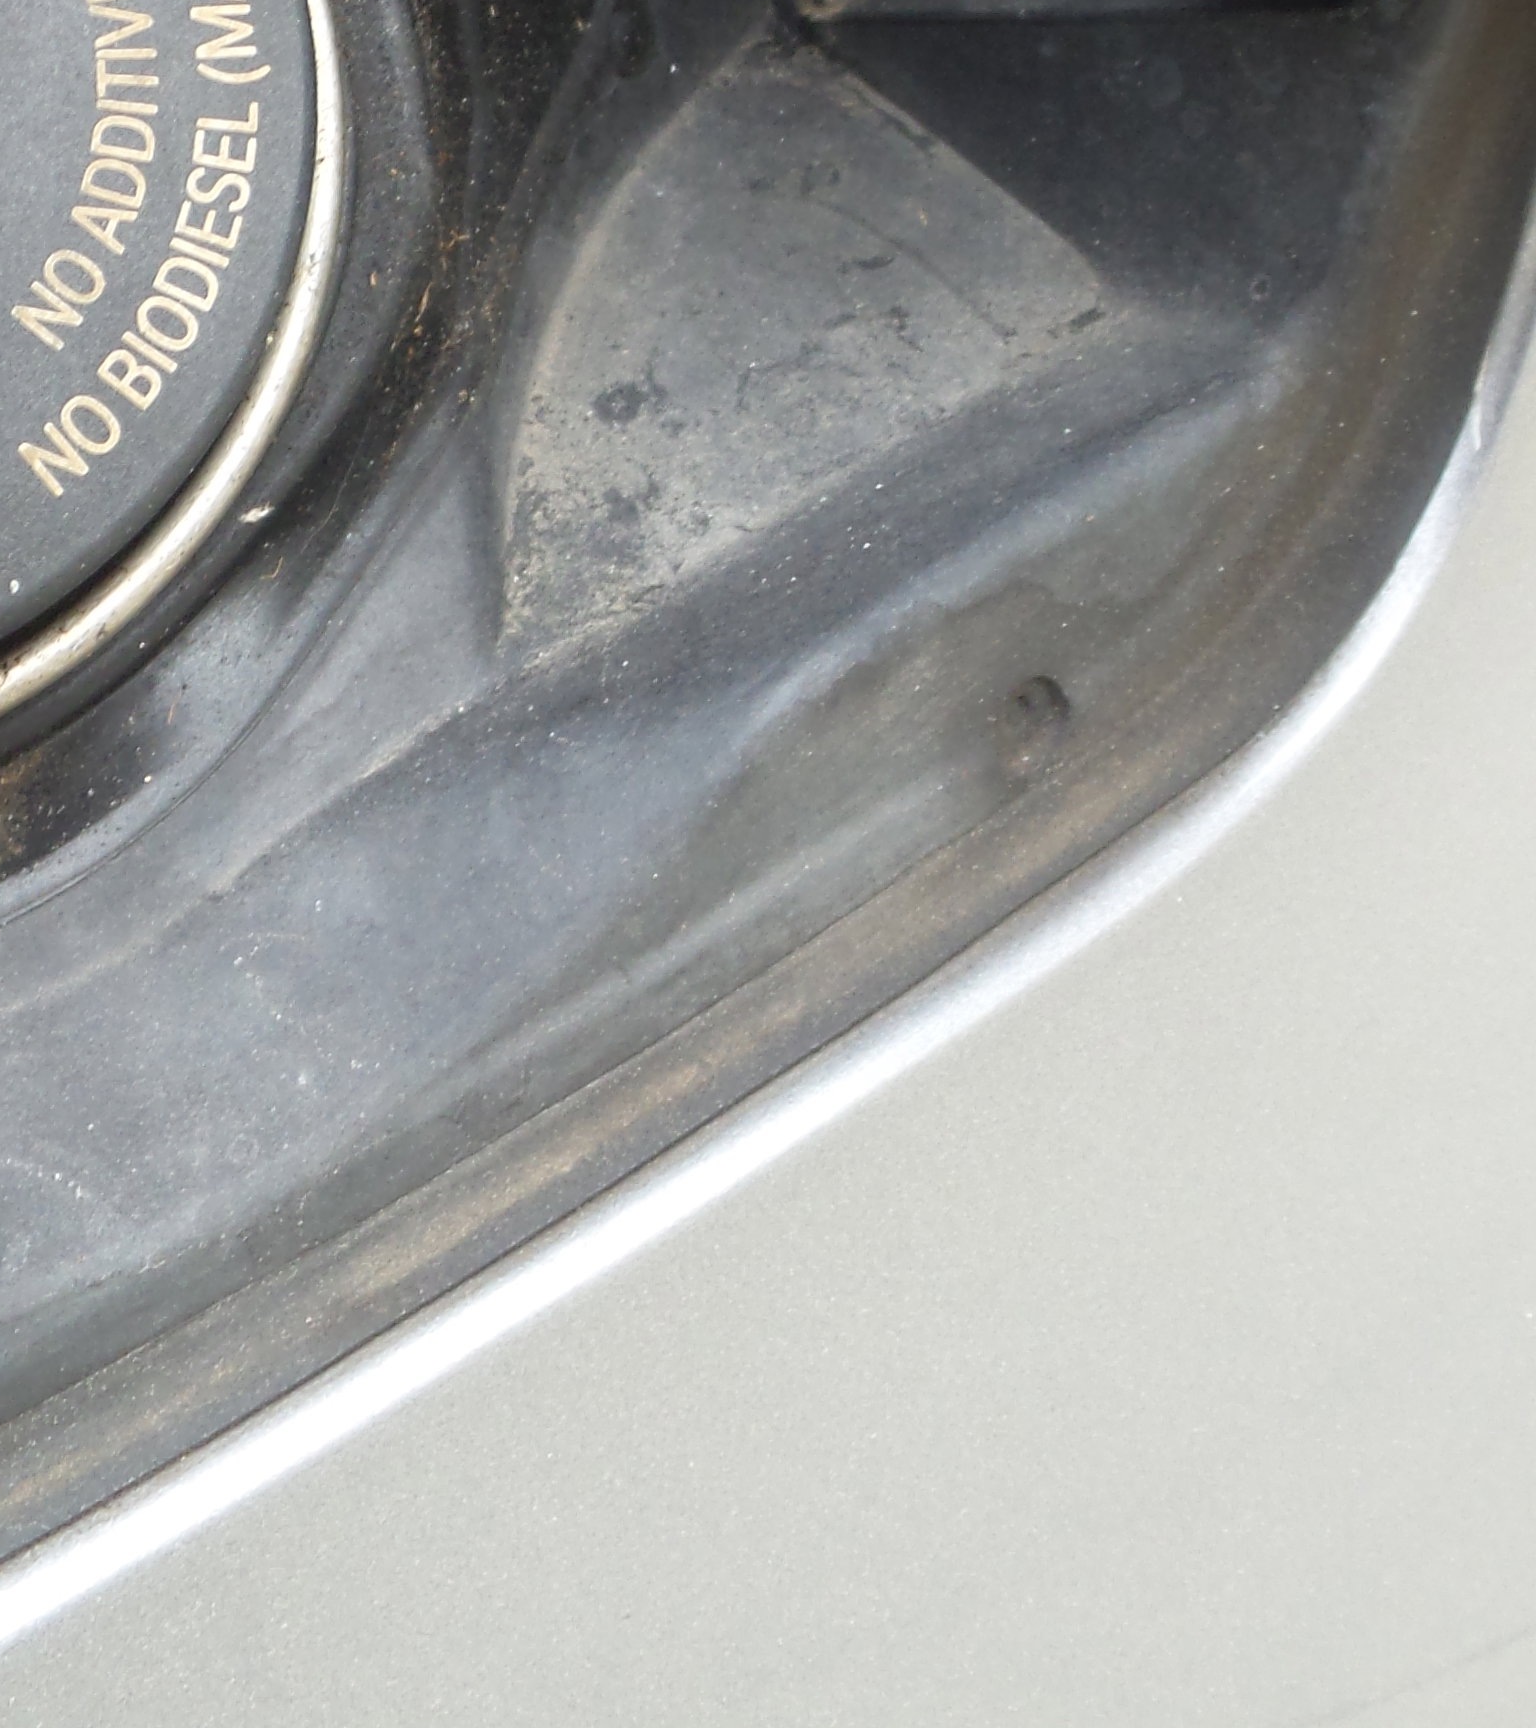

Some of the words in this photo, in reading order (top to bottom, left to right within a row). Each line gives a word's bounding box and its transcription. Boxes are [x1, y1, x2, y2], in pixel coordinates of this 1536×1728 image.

[10, 248, 108, 352] NO
[16, 394, 122, 498] NO
[96, 101, 260, 412] BIODIESEL
